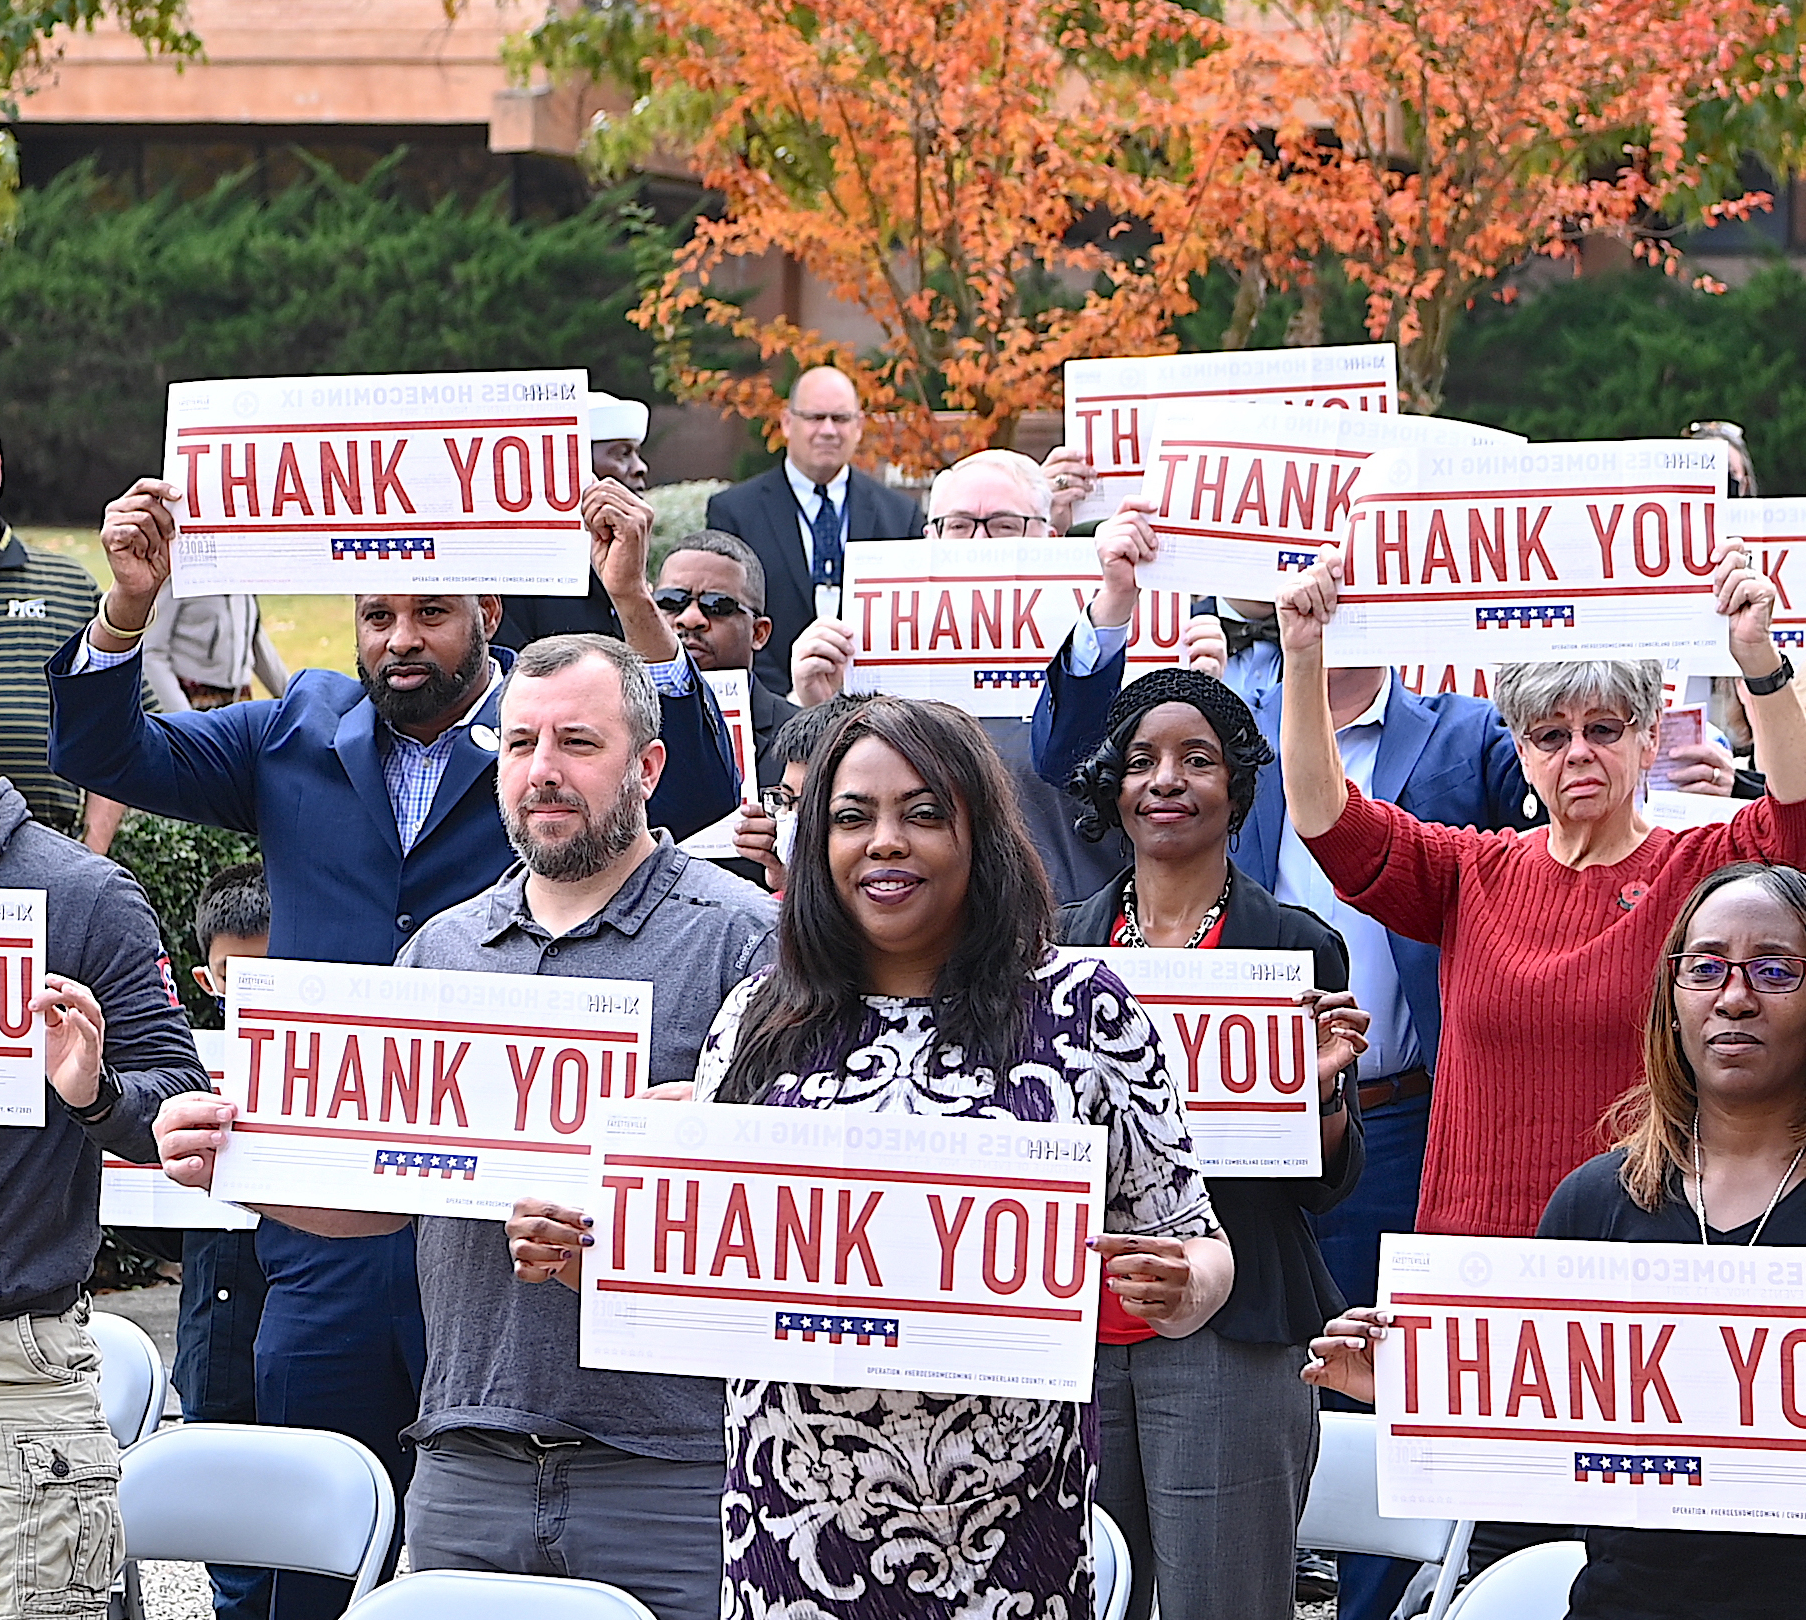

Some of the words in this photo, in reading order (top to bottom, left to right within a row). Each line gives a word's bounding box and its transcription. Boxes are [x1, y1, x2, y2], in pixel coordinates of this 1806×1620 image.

[177, 439, 416, 517] THANK
[444, 434, 579, 513] YOU
[1161, 454, 1362, 533] THANK
[1344, 506, 1558, 586] THANK
[1587, 502, 1716, 578] YOU
[854, 589, 1045, 651] THANK
[238, 1027, 467, 1127] THANK
[1174, 1013, 1305, 1094] YOU
[1027, 1141, 1091, 1162] HH-IX
[602, 1175, 883, 1287] THANK
[927, 1194, 1088, 1298] YOU
[1392, 1316, 1682, 1423] THANK
